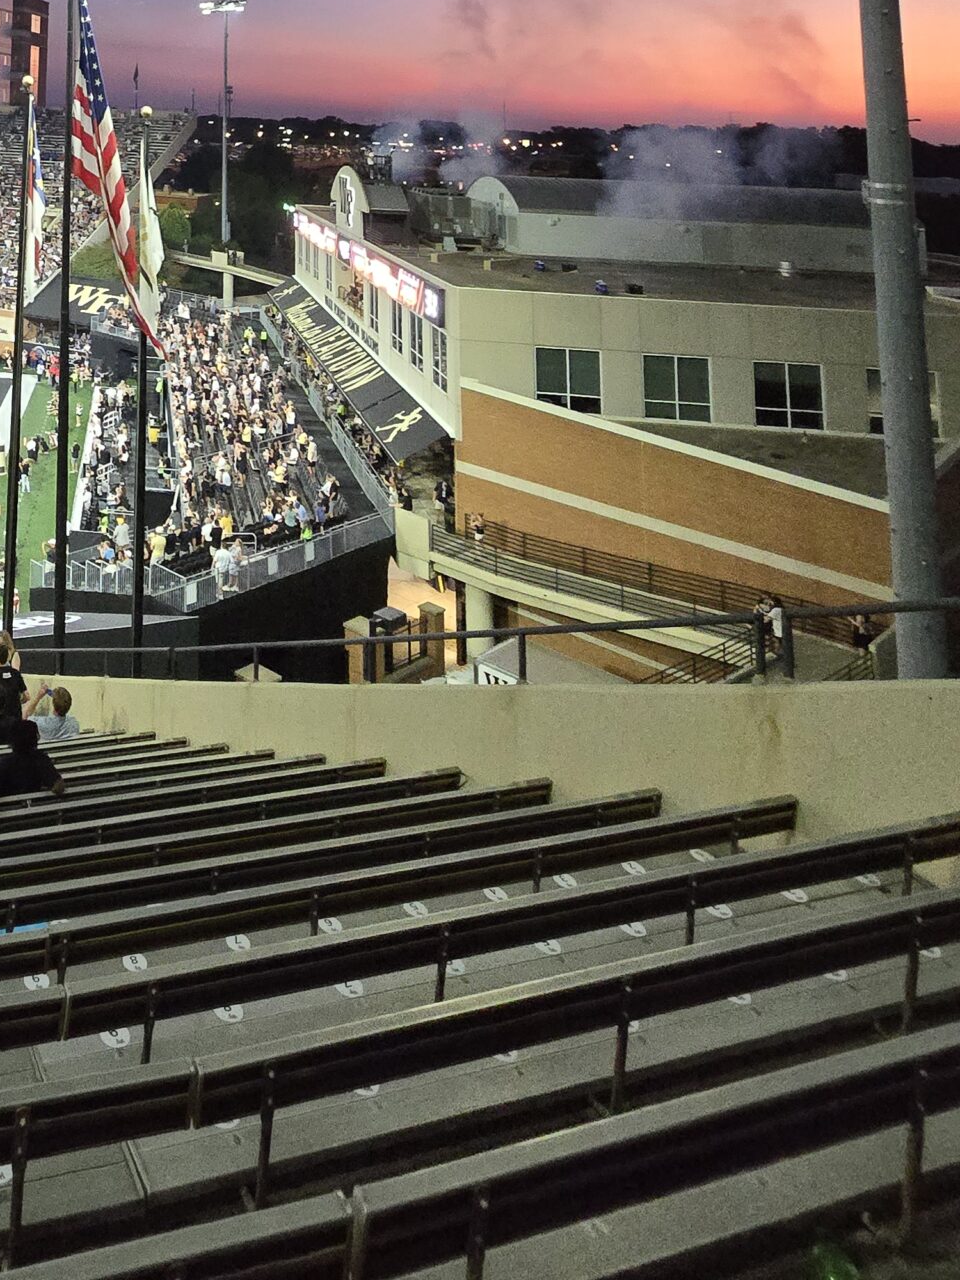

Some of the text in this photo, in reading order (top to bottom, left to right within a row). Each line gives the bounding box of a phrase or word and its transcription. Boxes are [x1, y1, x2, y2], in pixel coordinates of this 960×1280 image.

[307, 325, 385, 393] DEACTOWN
[235, 936, 242, 944] 7
[129, 956, 138, 964] 8
